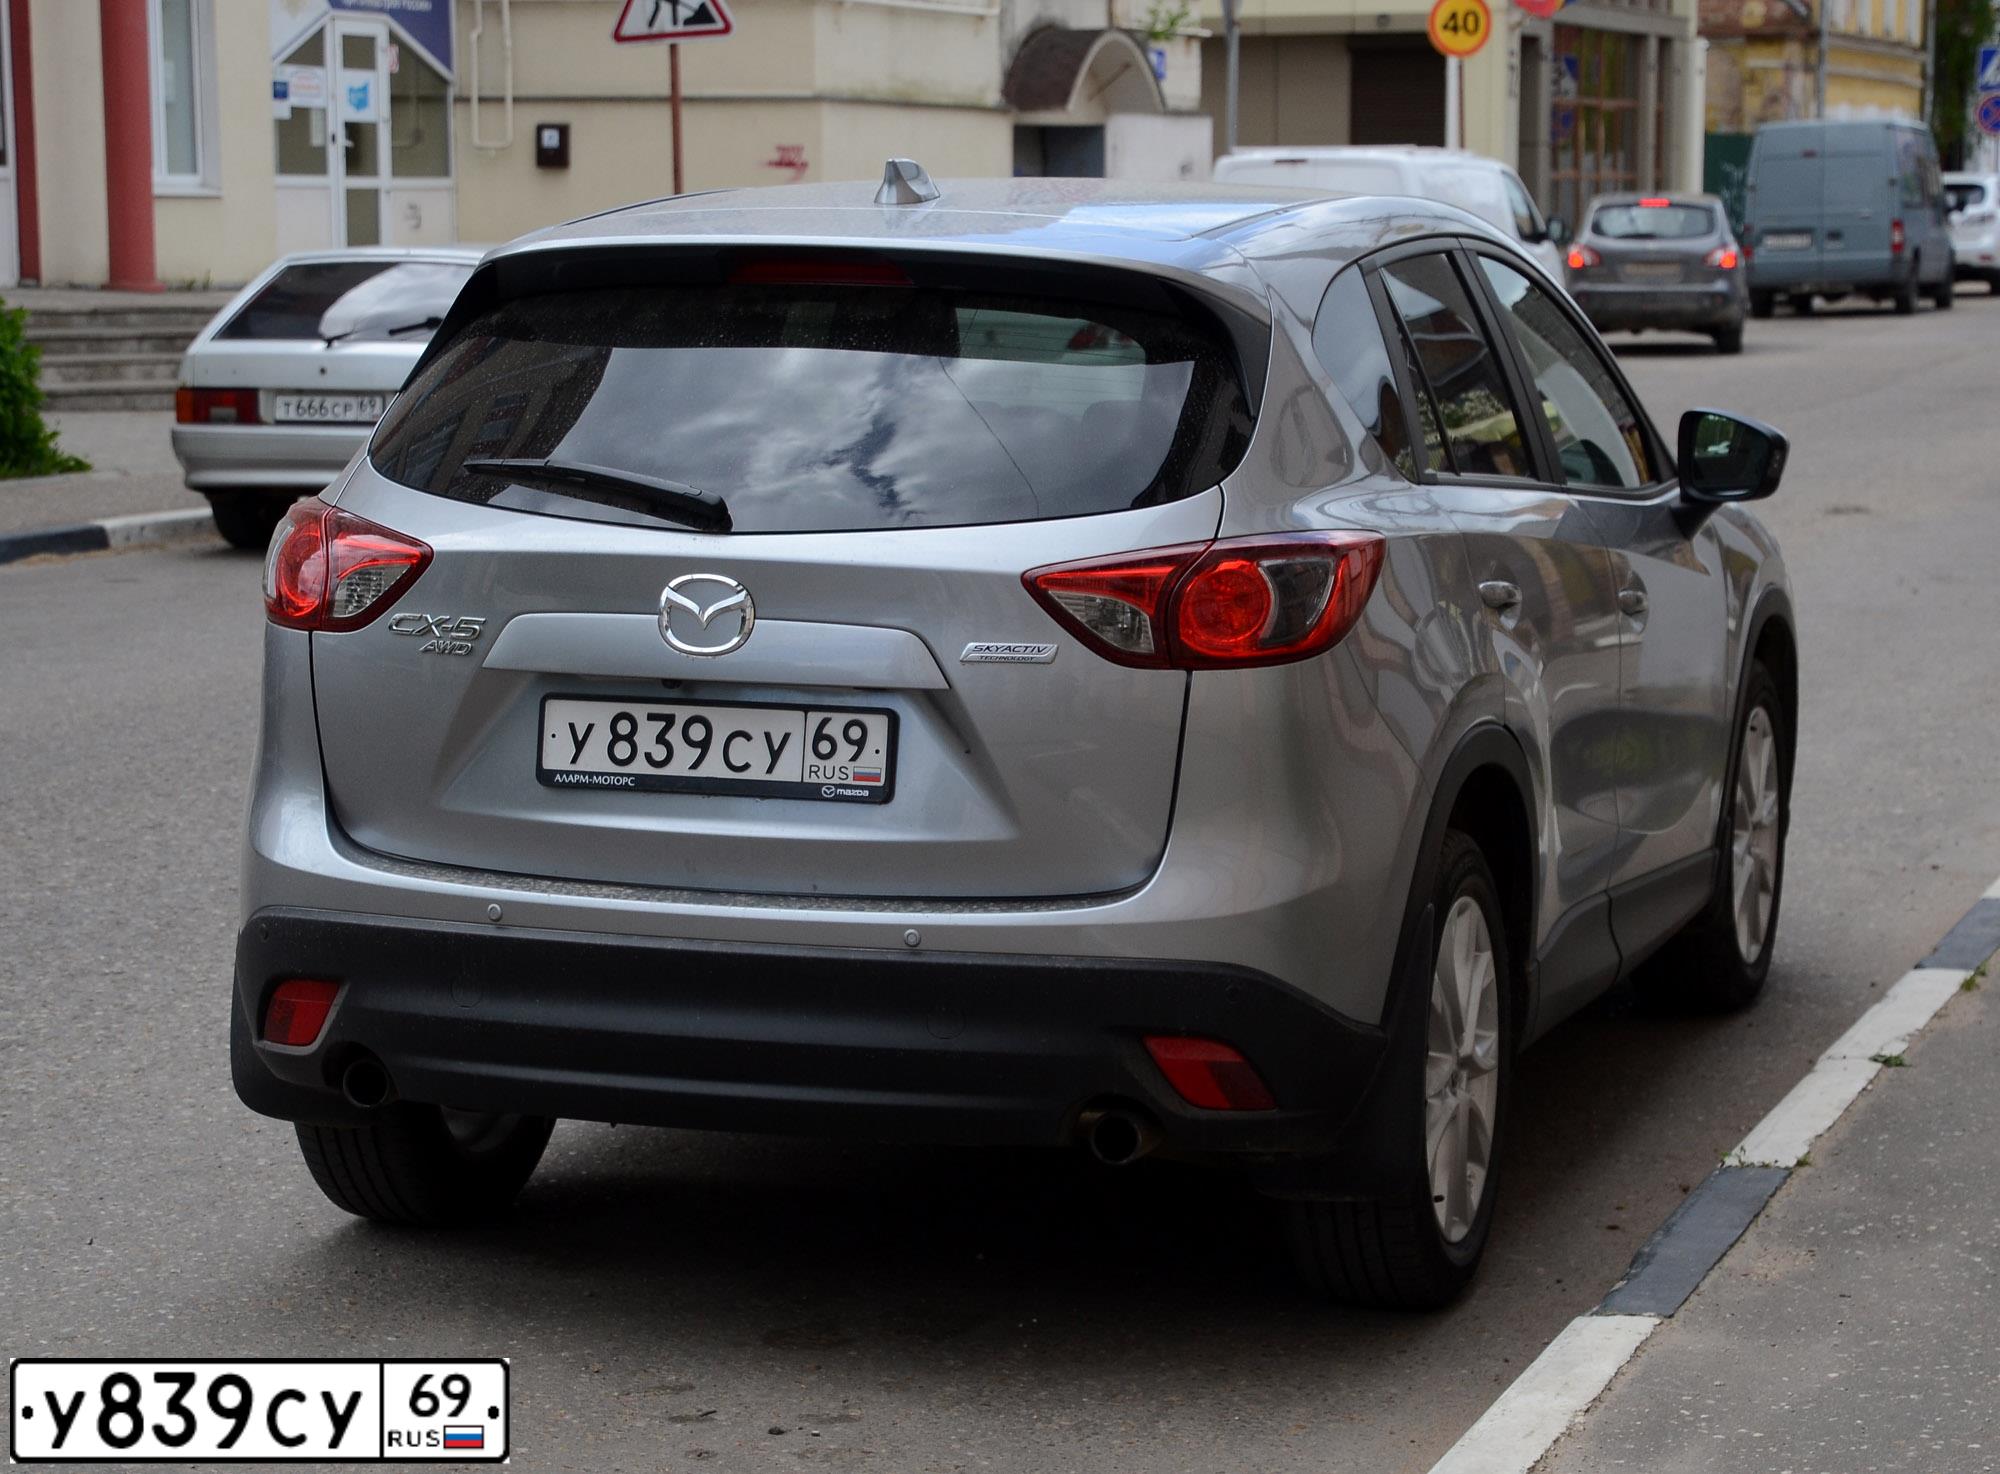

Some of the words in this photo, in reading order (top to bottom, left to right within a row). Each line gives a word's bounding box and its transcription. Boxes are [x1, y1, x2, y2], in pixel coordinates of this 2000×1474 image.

[1442, 10, 1480, 36] 40
[388, 612, 487, 641] CX-5
[418, 639, 474, 656] AWD
[972, 644, 1049, 654] SKYACTIV
[811, 716, 869, 763] 69
[808, 764, 850, 781] RUS
[836, 787, 870, 797] mazda
